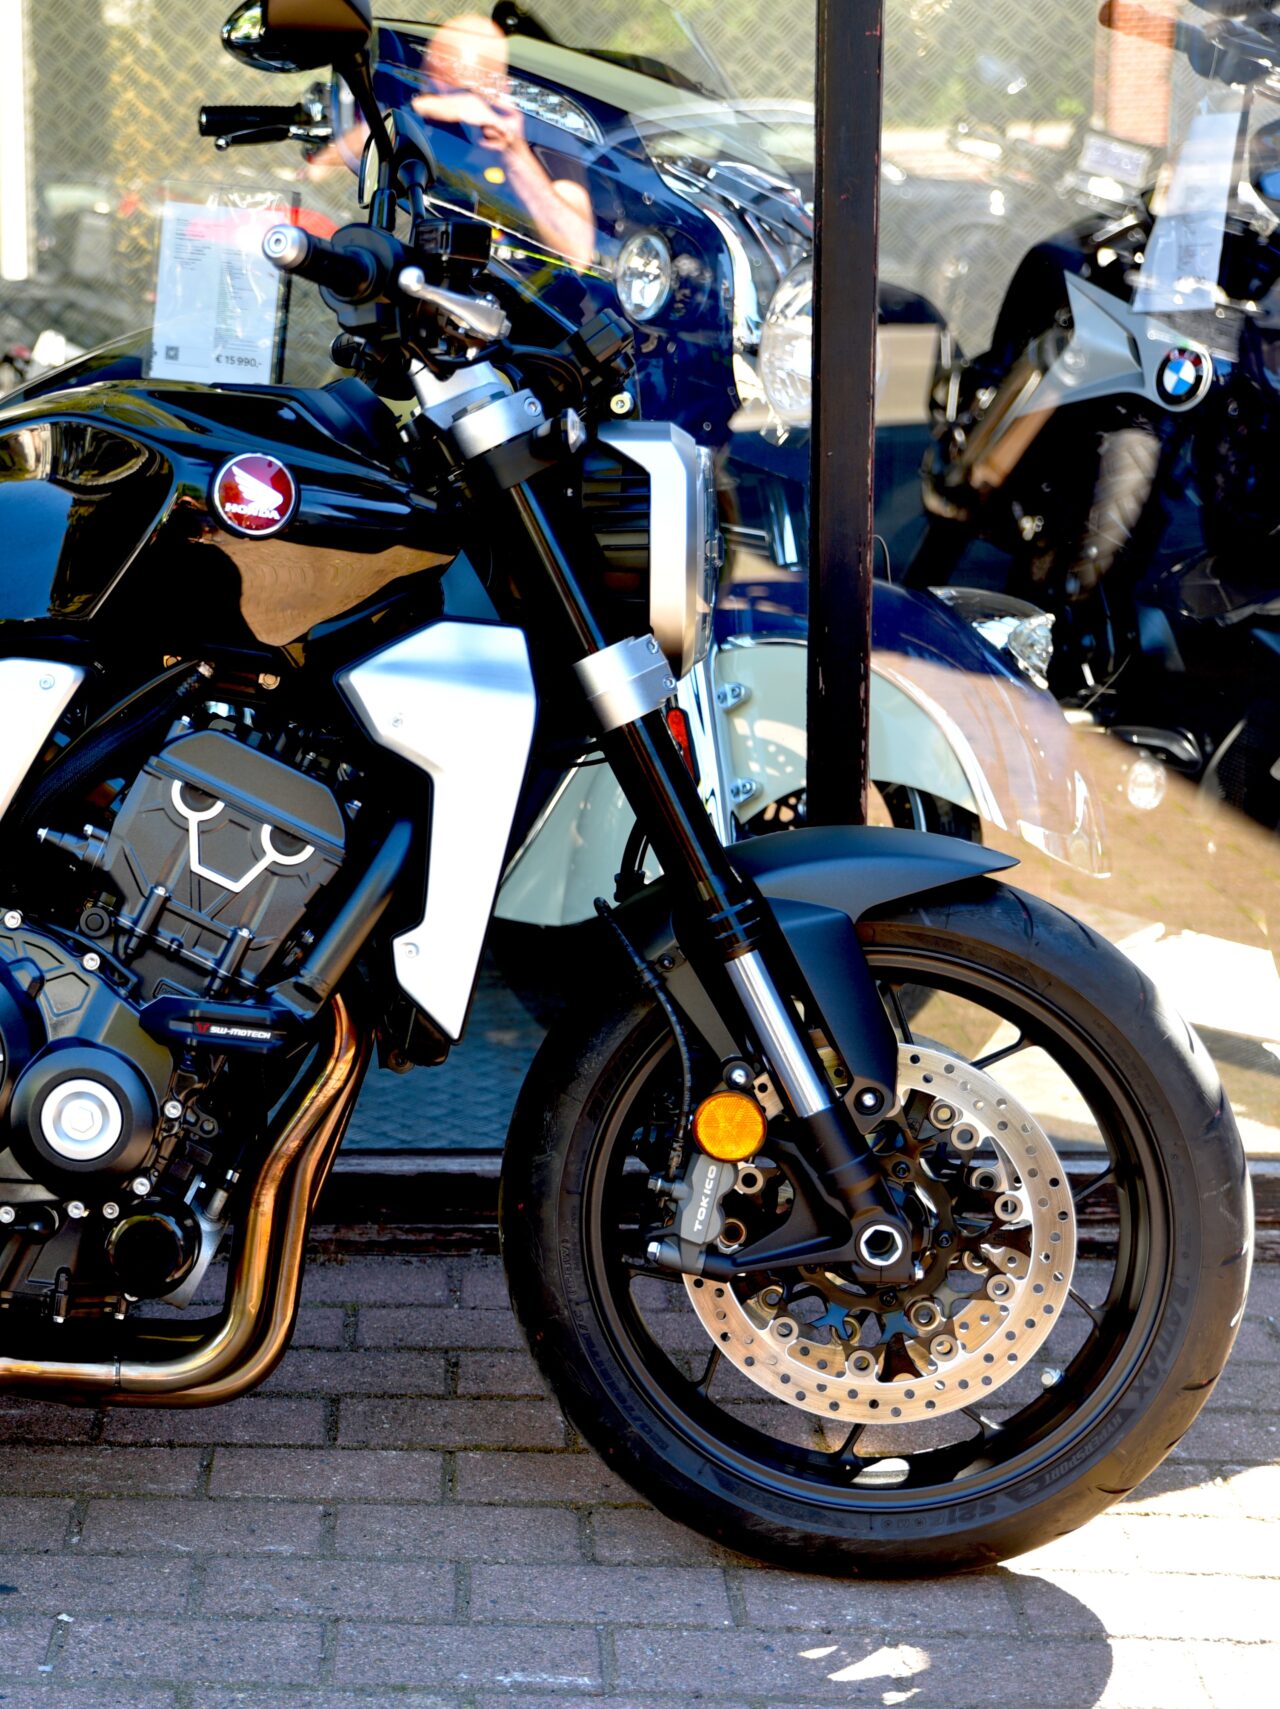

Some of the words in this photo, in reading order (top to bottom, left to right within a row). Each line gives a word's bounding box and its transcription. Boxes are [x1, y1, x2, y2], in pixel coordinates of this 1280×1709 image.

[215, 354, 223, 364] €
[224, 501, 280, 520] HONDA
[210, 1026, 271, 1039] SW-MOTECH
[693, 1165, 716, 1232] TOKICO
[1043, 1412, 1123, 1484] HYPERSPORT
